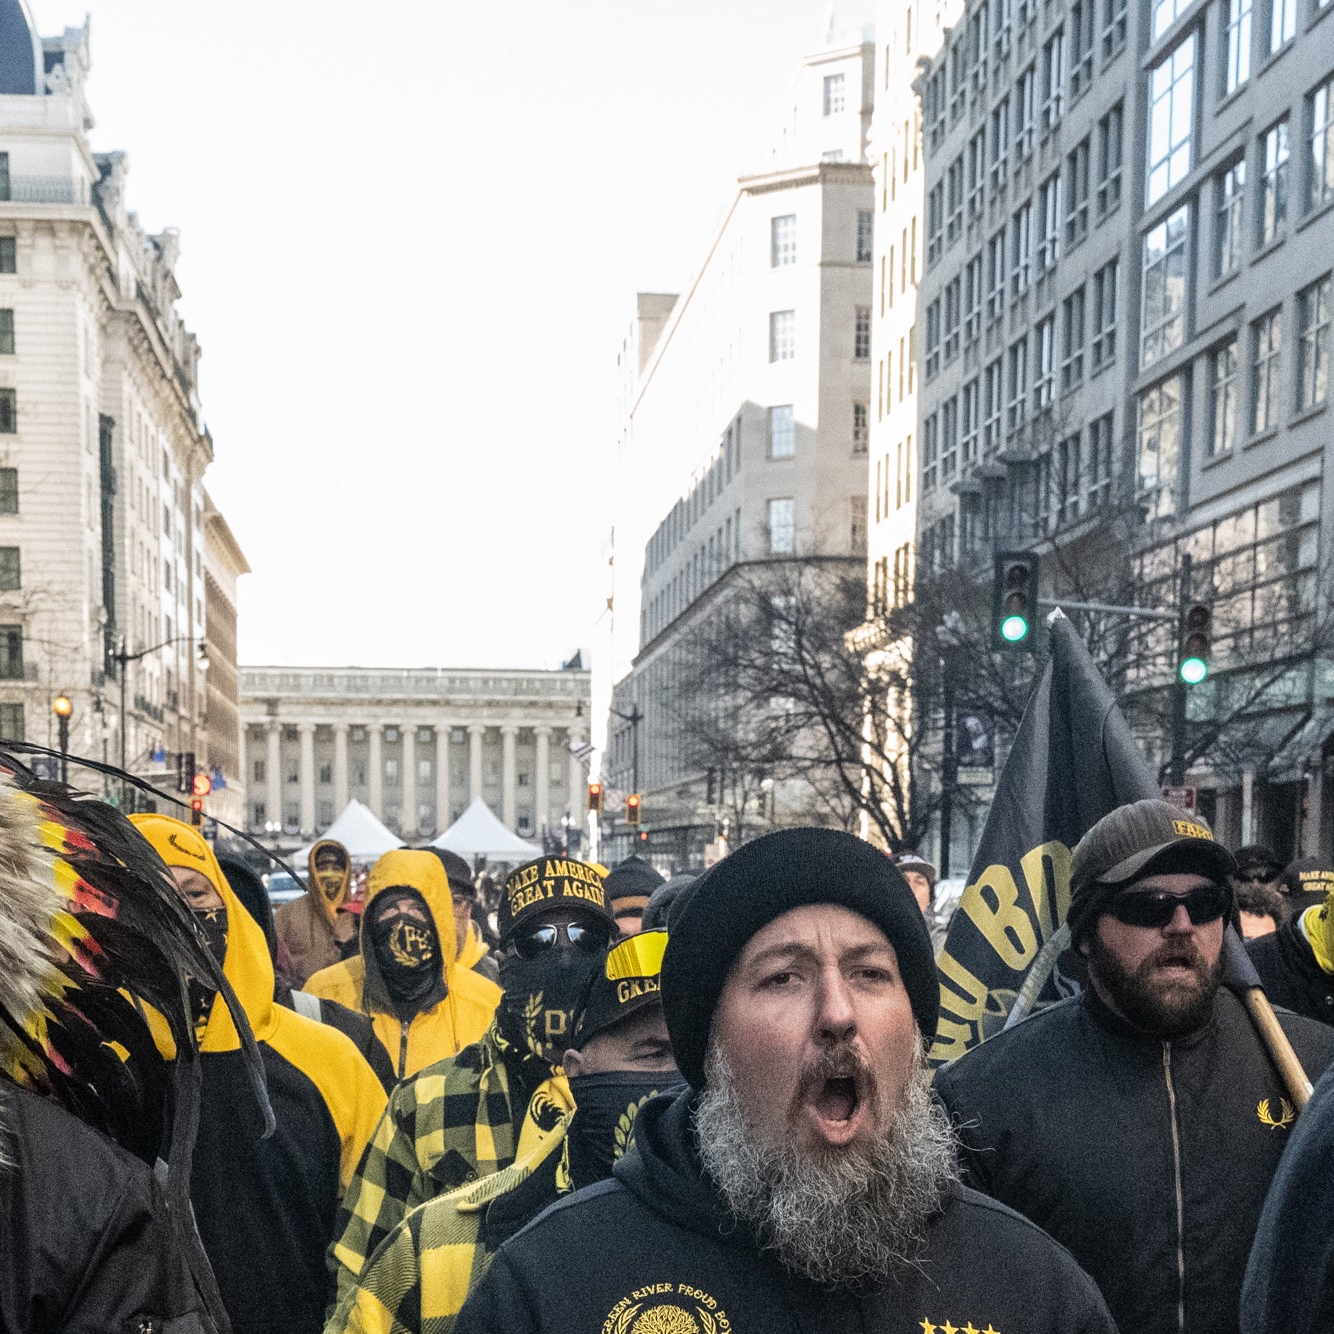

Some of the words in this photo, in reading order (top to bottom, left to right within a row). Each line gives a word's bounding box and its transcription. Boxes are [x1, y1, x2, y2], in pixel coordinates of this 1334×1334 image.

[507, 865, 539, 901] MAKE
[510, 880, 555, 917] GREAT
[631, 1282, 674, 1301] RIVER
[678, 1283, 718, 1310] PROUD
